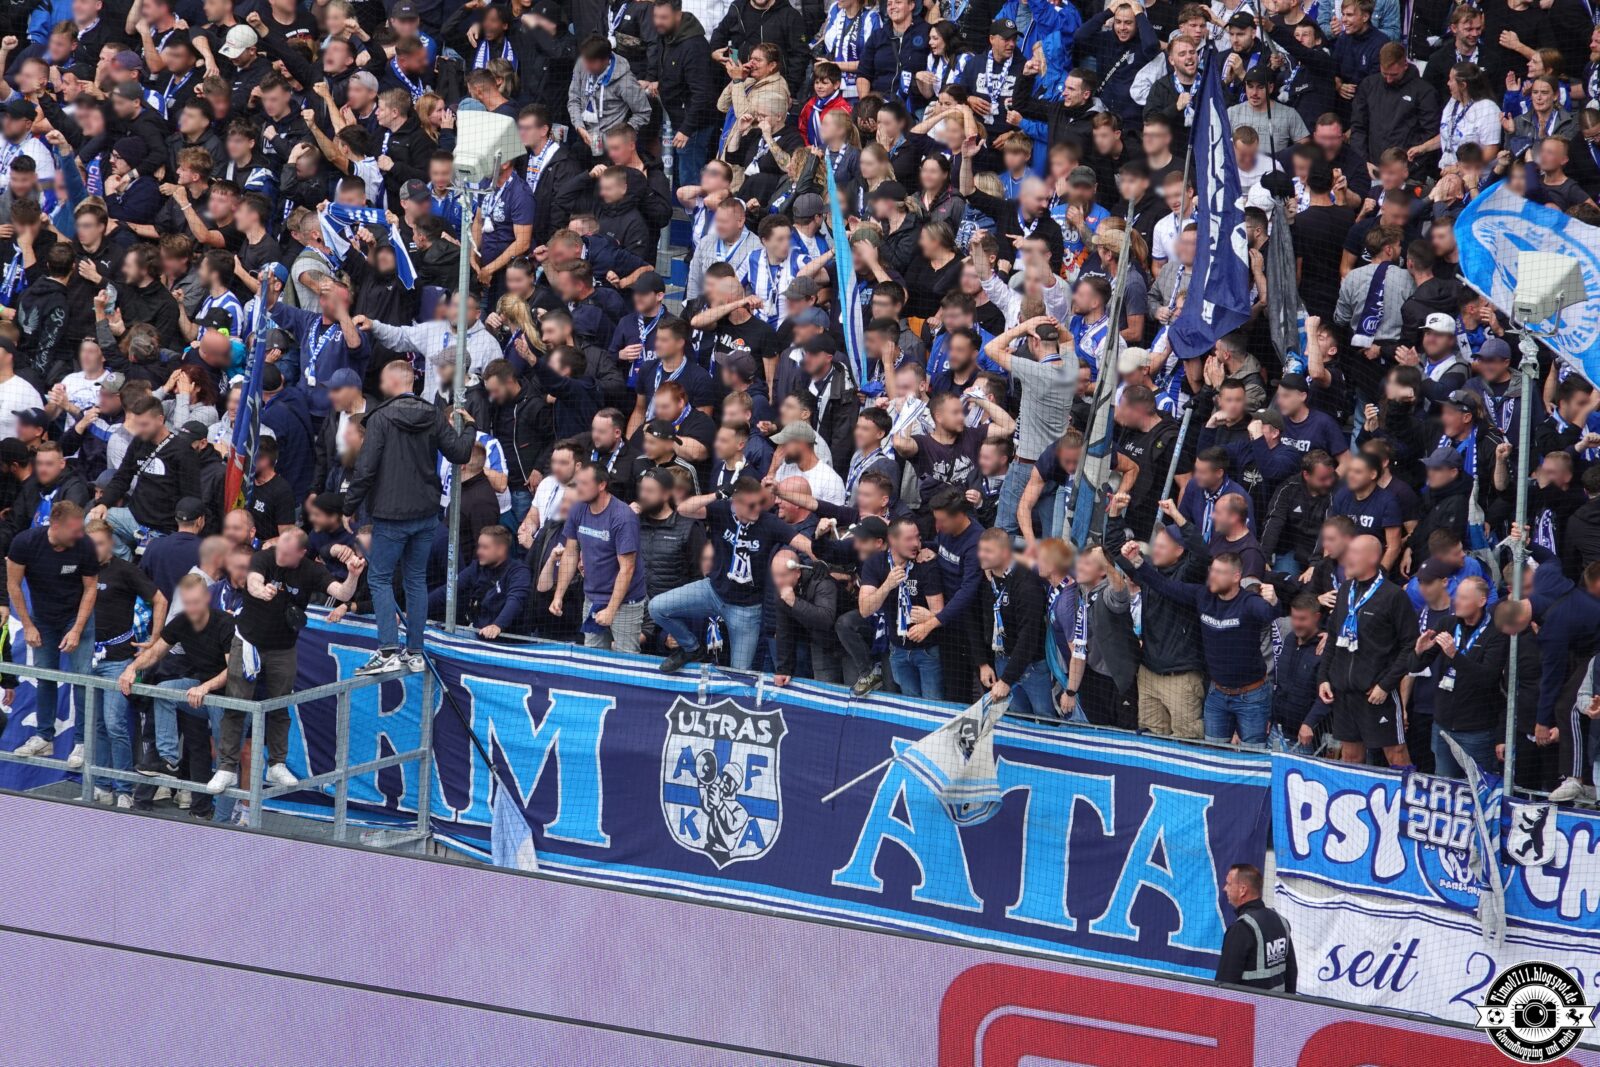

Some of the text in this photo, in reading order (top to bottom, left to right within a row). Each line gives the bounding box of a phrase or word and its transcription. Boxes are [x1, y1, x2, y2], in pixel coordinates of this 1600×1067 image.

[280, 643, 617, 848] RM
[678, 711, 773, 744] ULTRAS
[673, 745, 769, 792] A F
[1405, 772, 1474, 818] CRE
[679, 807, 766, 849] K A
[831, 736, 1228, 955] ATA
[1286, 769, 1407, 883] PSY
[1407, 806, 1473, 850] 200
[1317, 938, 1420, 992] seit
